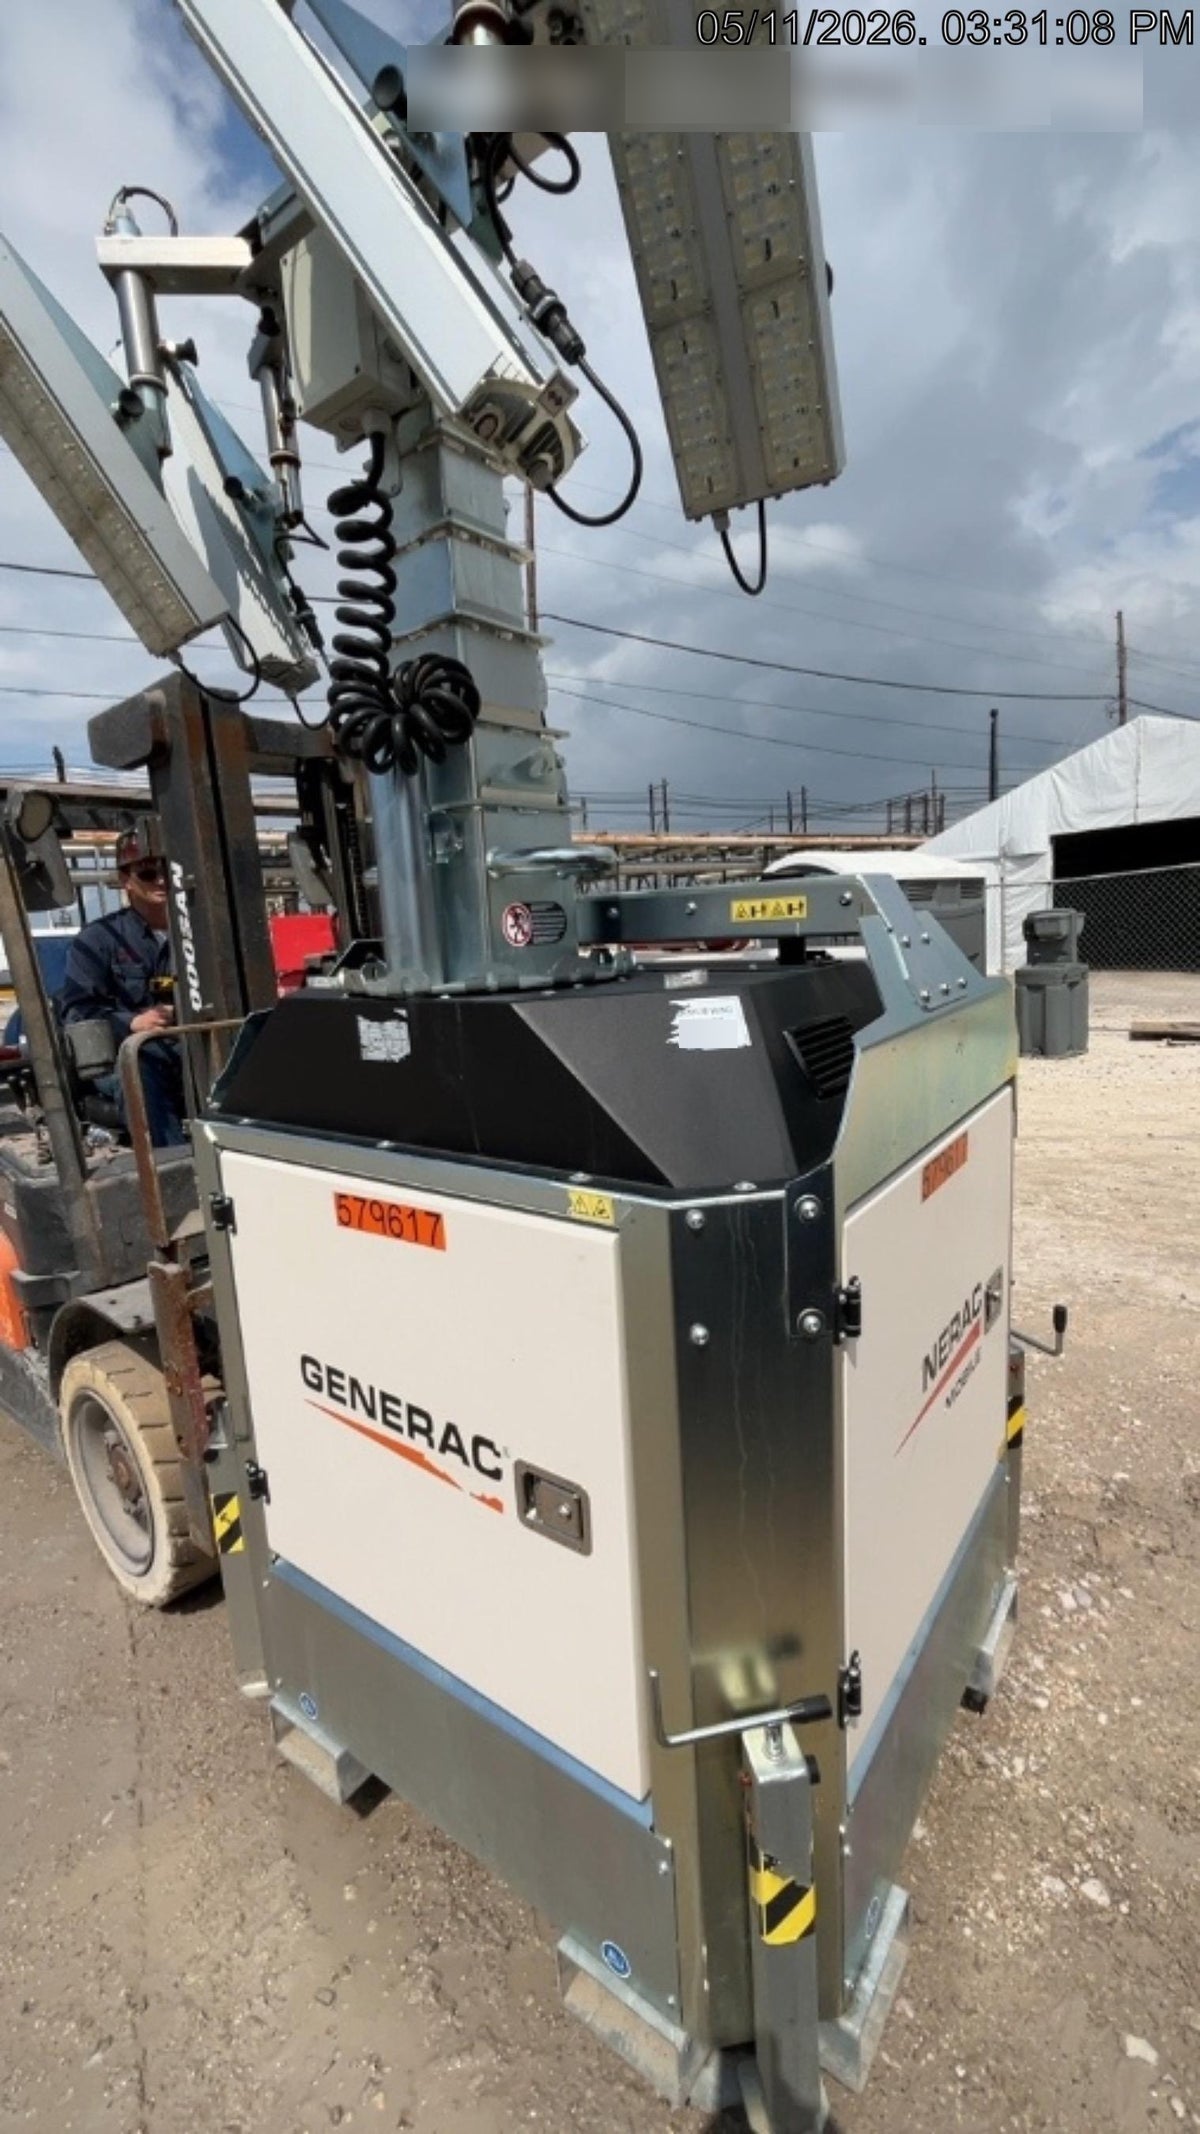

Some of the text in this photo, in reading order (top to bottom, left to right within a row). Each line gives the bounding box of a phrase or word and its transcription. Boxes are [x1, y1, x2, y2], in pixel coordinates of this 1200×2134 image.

[170, 861, 203, 1013] DOOSAN
[337, 1194, 443, 1247] 579617
[300, 1353, 504, 1482] GENERAC
